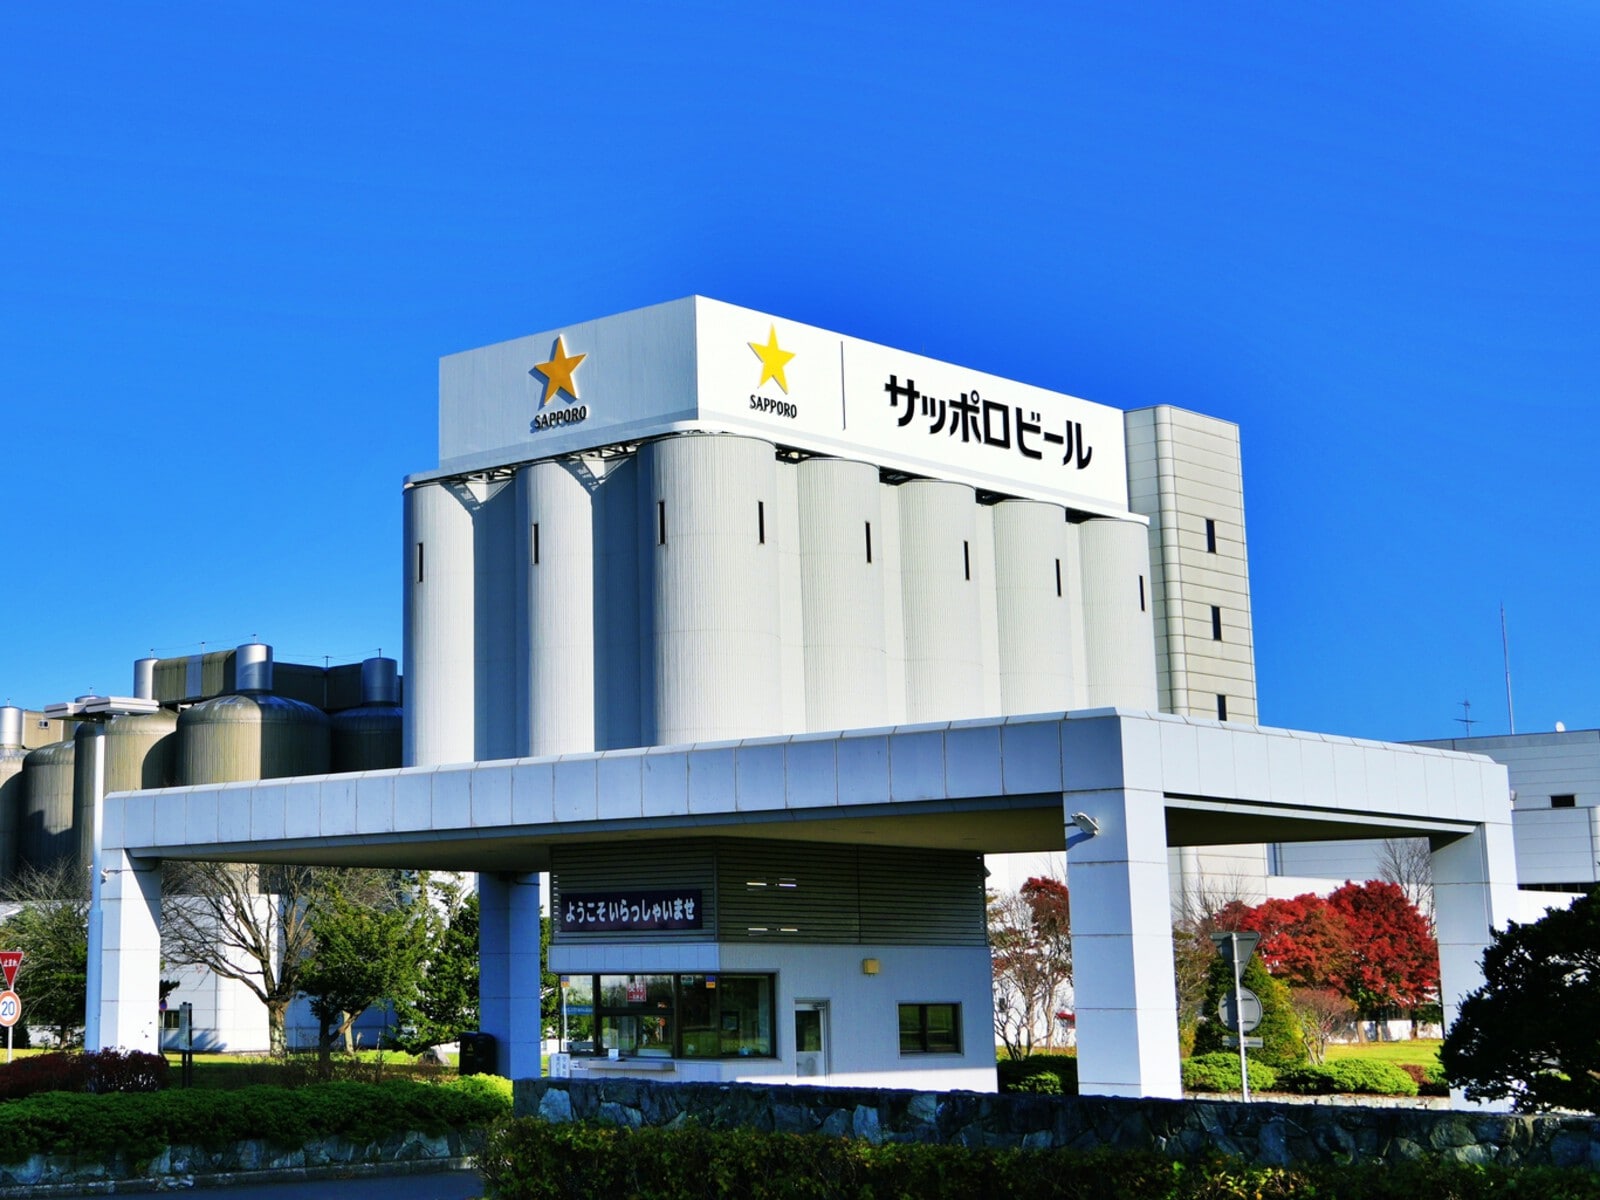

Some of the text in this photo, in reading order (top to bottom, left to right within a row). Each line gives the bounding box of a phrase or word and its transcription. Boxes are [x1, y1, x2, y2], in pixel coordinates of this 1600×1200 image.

[534, 405, 588, 429] SAPPORO
[749, 395, 798, 419] SAPPORO
[884, 374, 1093, 469] サッポロビール
[1, 1001, 15, 1016] 20
